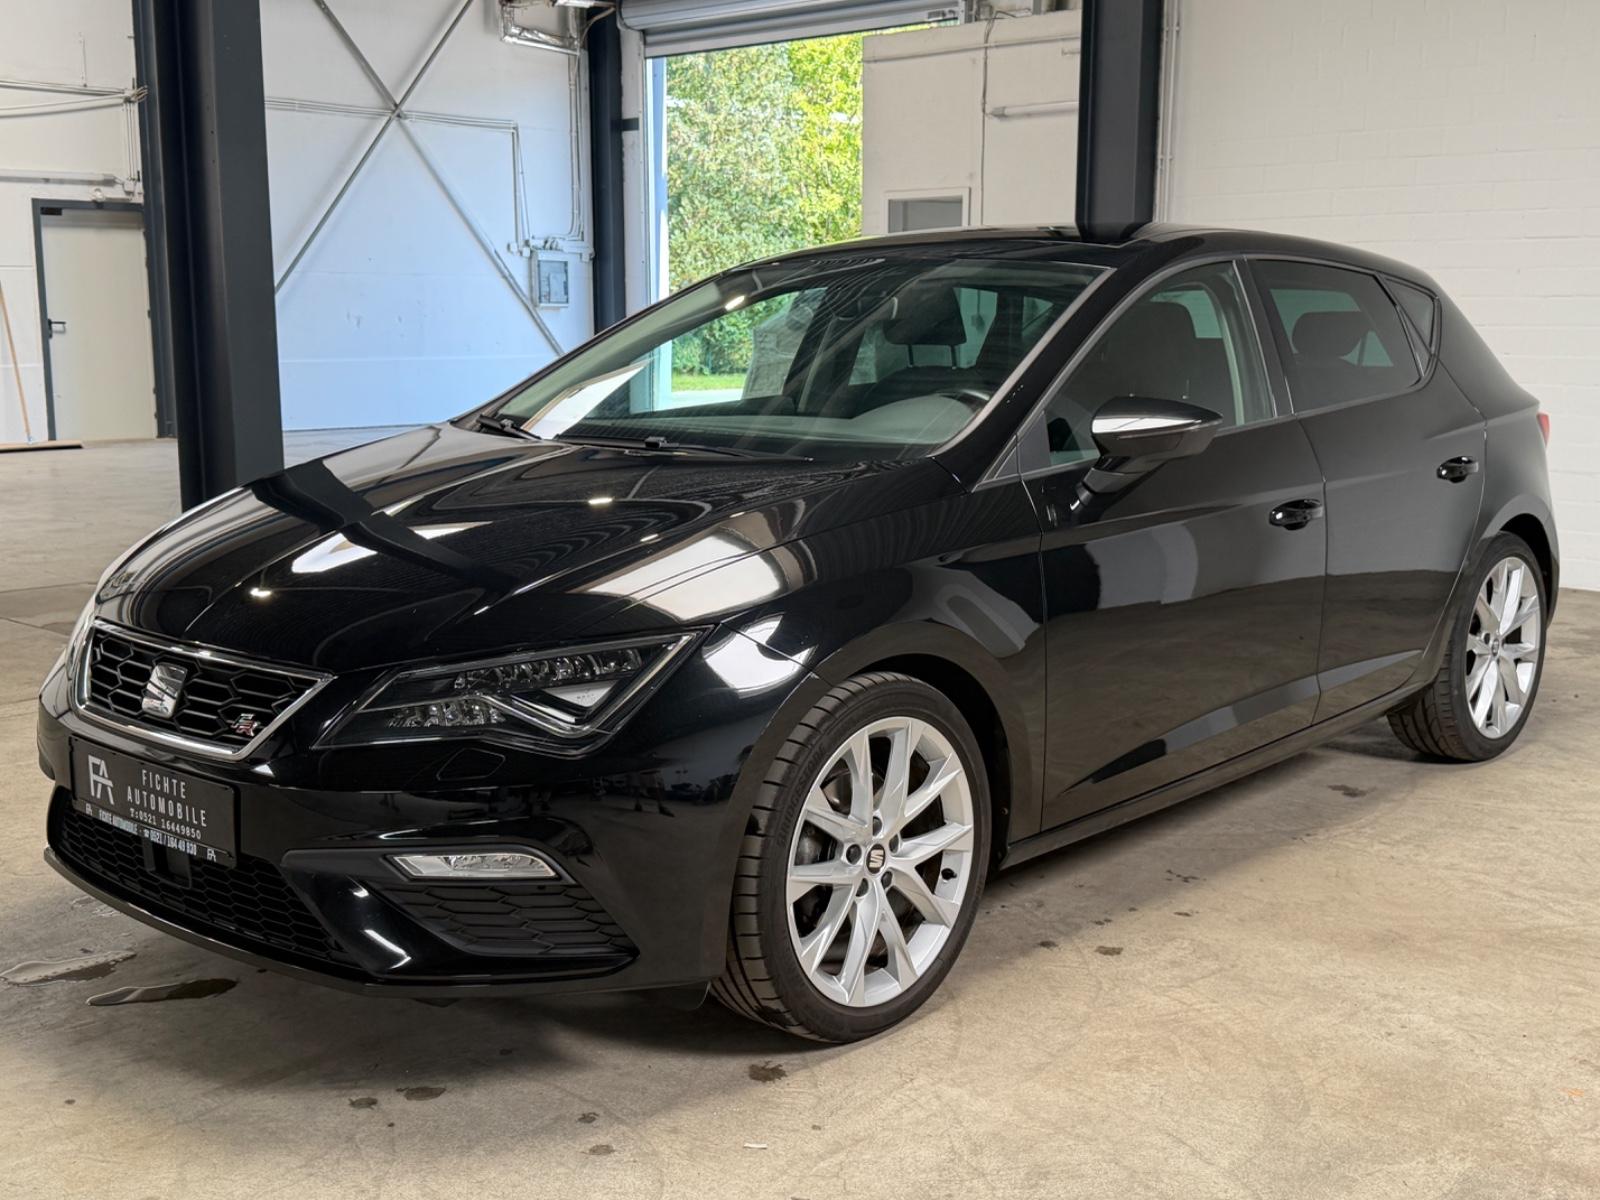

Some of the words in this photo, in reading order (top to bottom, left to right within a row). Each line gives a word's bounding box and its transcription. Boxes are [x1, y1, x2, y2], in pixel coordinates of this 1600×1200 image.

[141, 769, 187, 799] FICHTE
[127, 786, 207, 827] AUTOMOBILE
[161, 818, 202, 840] 16449850
